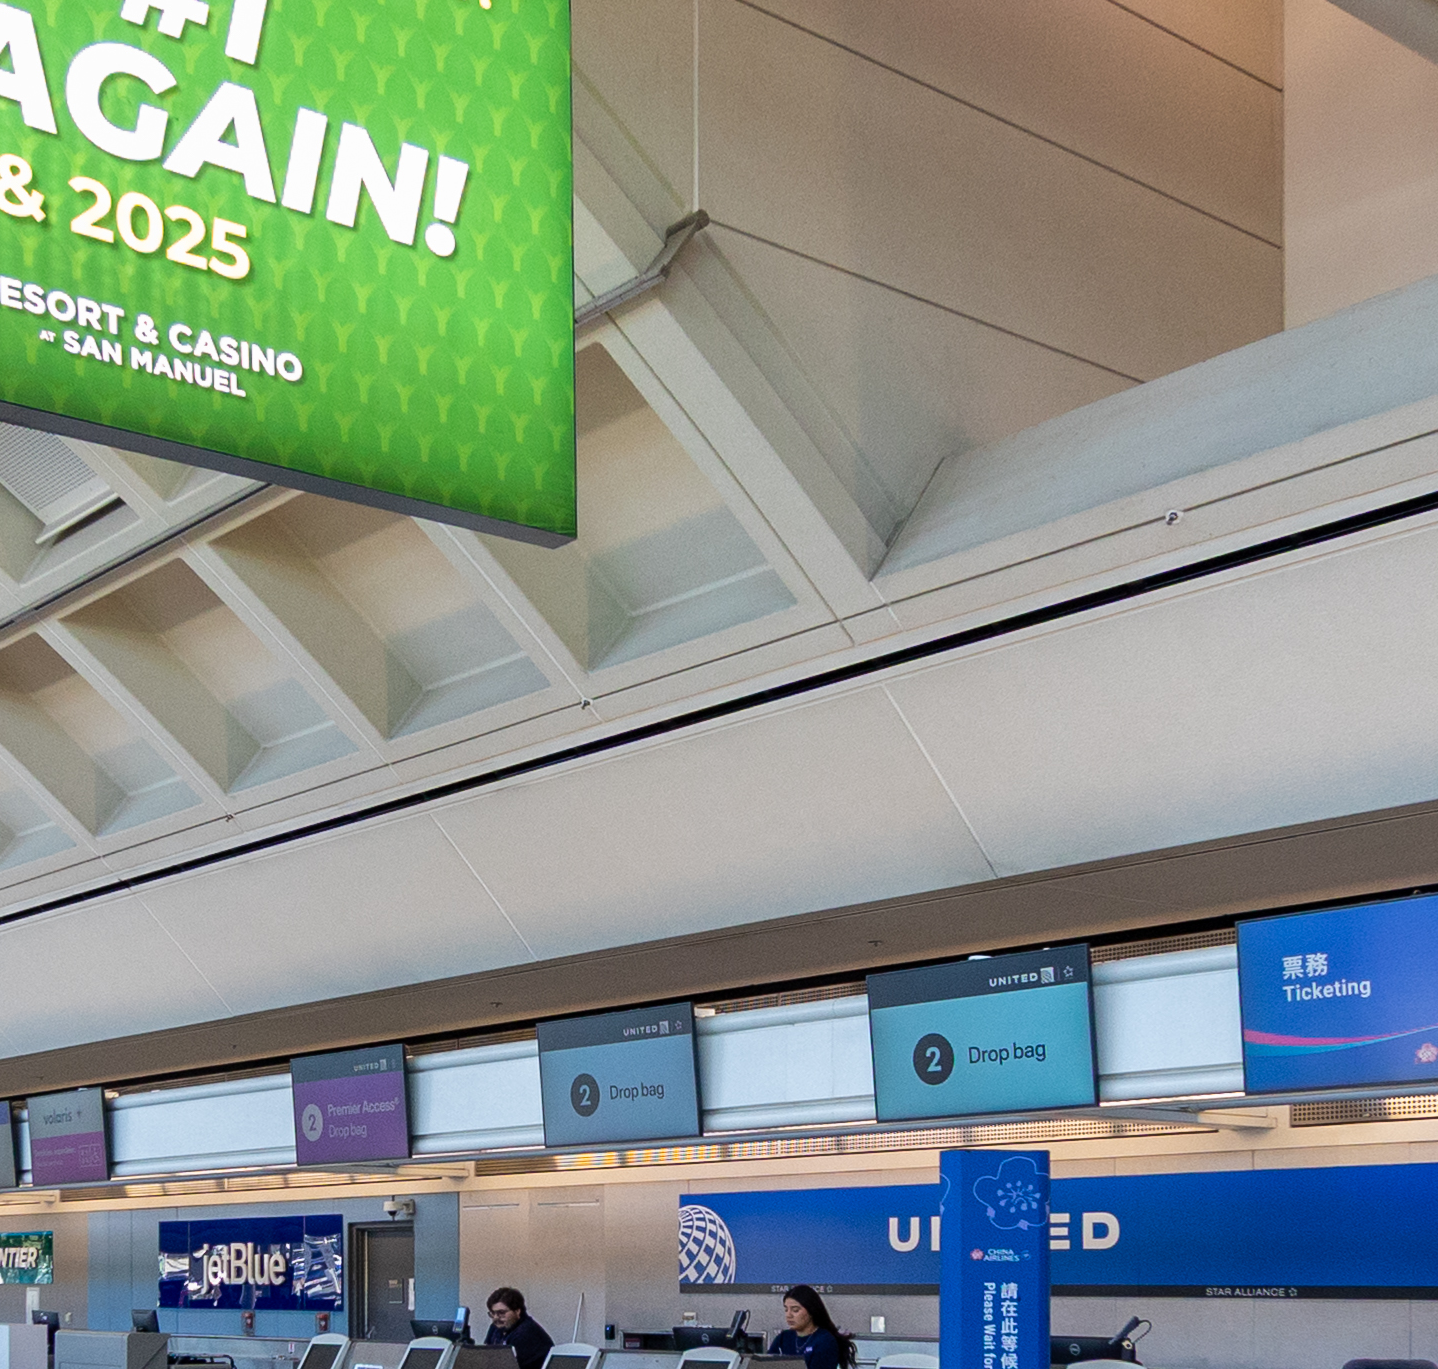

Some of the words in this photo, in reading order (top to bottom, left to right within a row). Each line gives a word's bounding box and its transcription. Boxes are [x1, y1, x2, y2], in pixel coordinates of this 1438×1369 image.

[67, 176, 252, 280] 2025
[134, 313, 160, 346] &
[168, 323, 304, 382] CASINO
[38, 329, 57, 343] AT
[62, 330, 123, 366] SAN
[129, 347, 247, 398] MANUEL
[1282, 952, 1329, 980] 票務
[989, 972, 1039, 988] UNITED
[1282, 979, 1372, 1003] Ticketing
[622, 1024, 659, 1038] UNITED
[353, 1062, 379, 1072] UNITED
[925, 1046, 943, 1073] 2
[968, 1043, 1009, 1068] Drop
[1011, 1040, 1047, 1065] bag
[577, 1083, 592, 1107] 2
[608, 1080, 637, 1103] Drop
[638, 1078, 666, 1102] bag
[44, 1109, 73, 1126] volaris
[308, 1113, 317, 1132] 2
[328, 1101, 362, 1117] Premier
[328, 1124, 350, 1140] Drop
[351, 1123, 368, 1139] bag
[888, 1211, 1121, 1252] UED
[983, 1254, 1020, 1262] AIRLINES
[987, 1248, 1015, 1256] CHINA
[200, 1241, 287, 1295] jetBlue
[983, 1281, 997, 1322] Please
[1205, 1286, 1231, 1298] STAR
[1233, 1286, 1286, 1298] ALLIANCE
[983, 1324, 997, 1351] Wait
